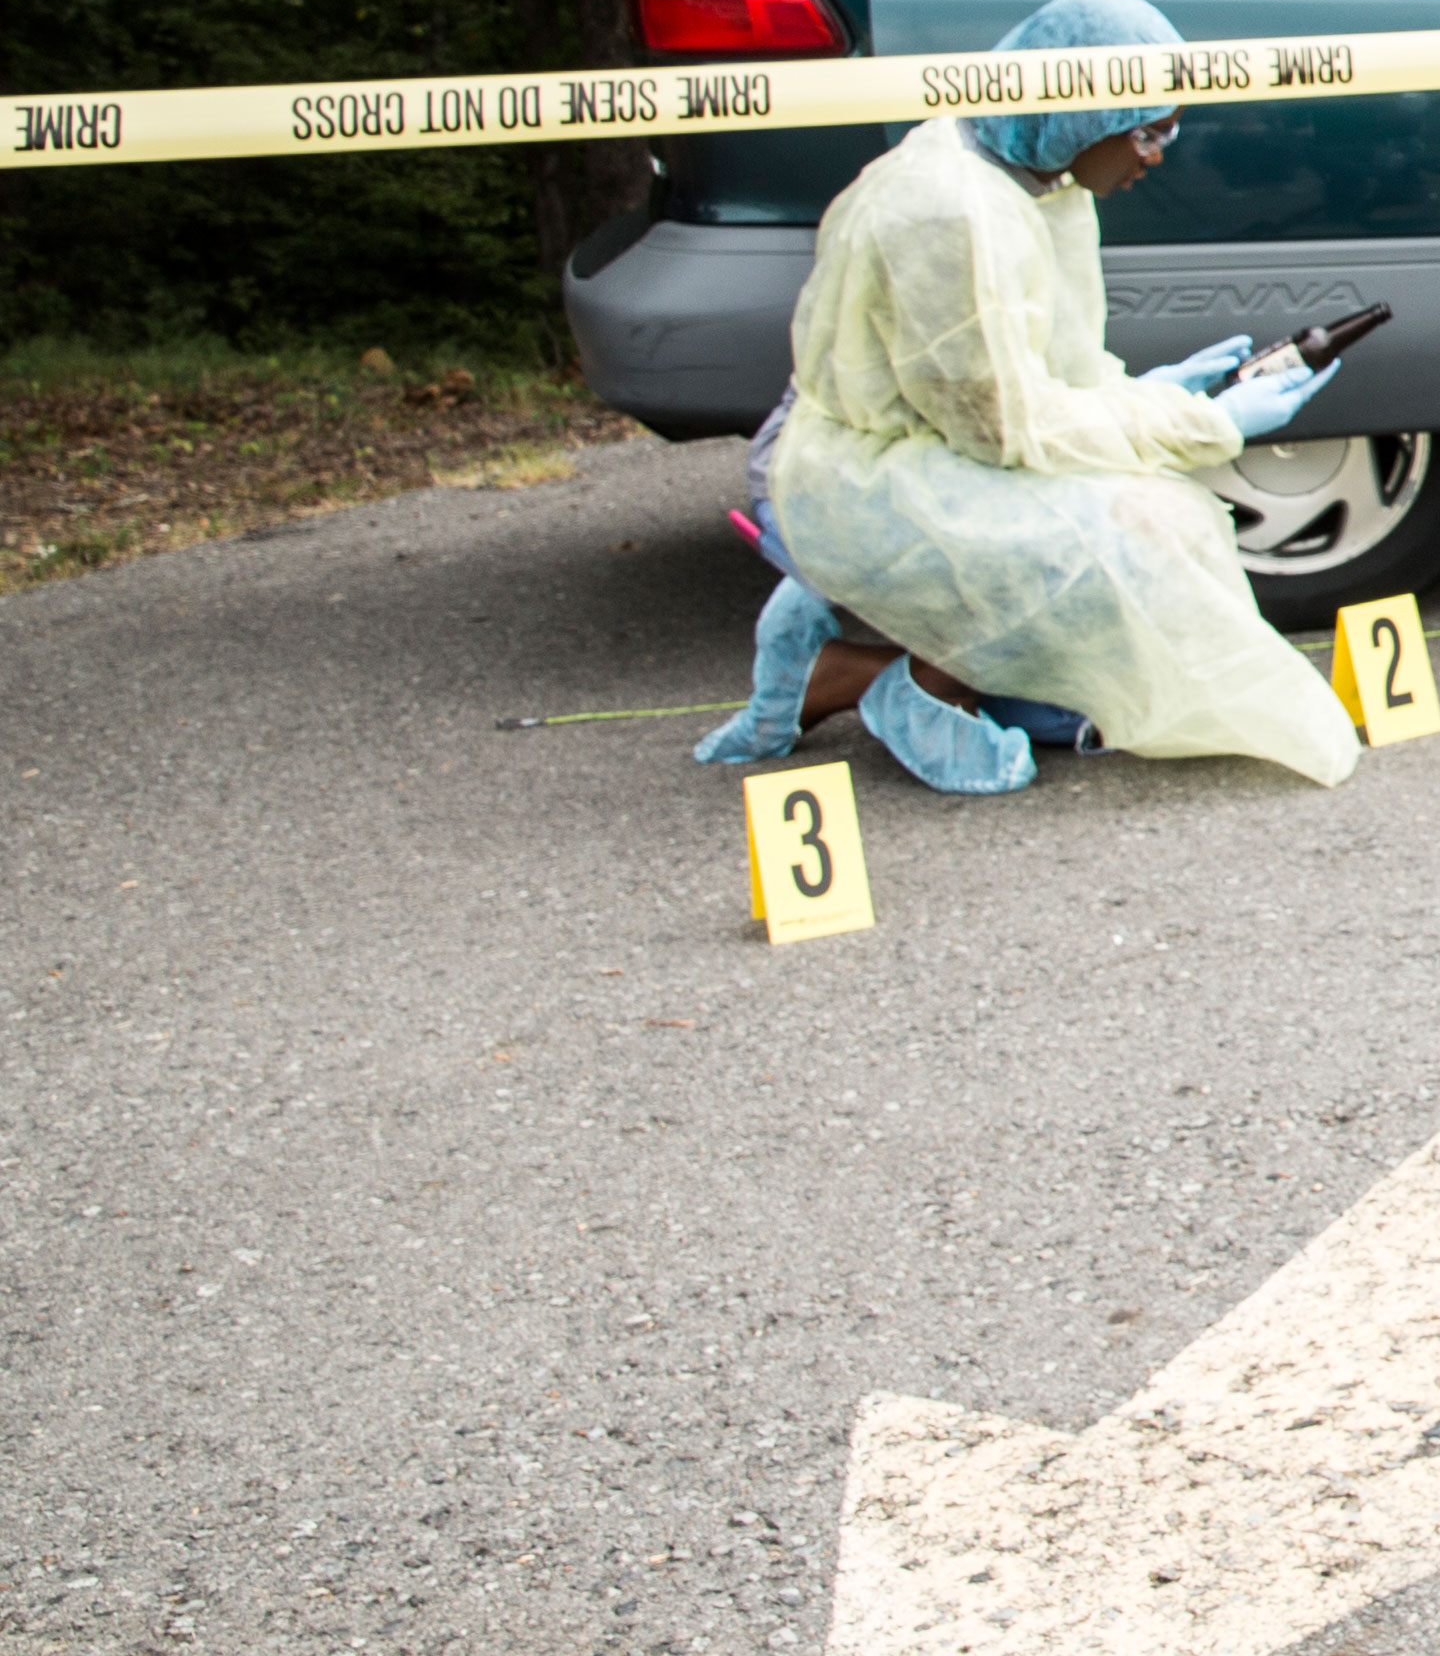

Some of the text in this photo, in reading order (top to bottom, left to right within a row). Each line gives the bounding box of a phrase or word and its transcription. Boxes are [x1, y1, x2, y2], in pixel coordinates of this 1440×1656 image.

[291, 73, 772, 140] CRIME SCENE DO NOT CROSS
[922, 45, 1354, 107] CRIME SCENE DO NOT CROSS
[14, 103, 122, 152] CRIME
[1106, 280, 1369, 318] SIENNA
[1371, 617, 1414, 709] 2
[783, 788, 834, 898] 3
